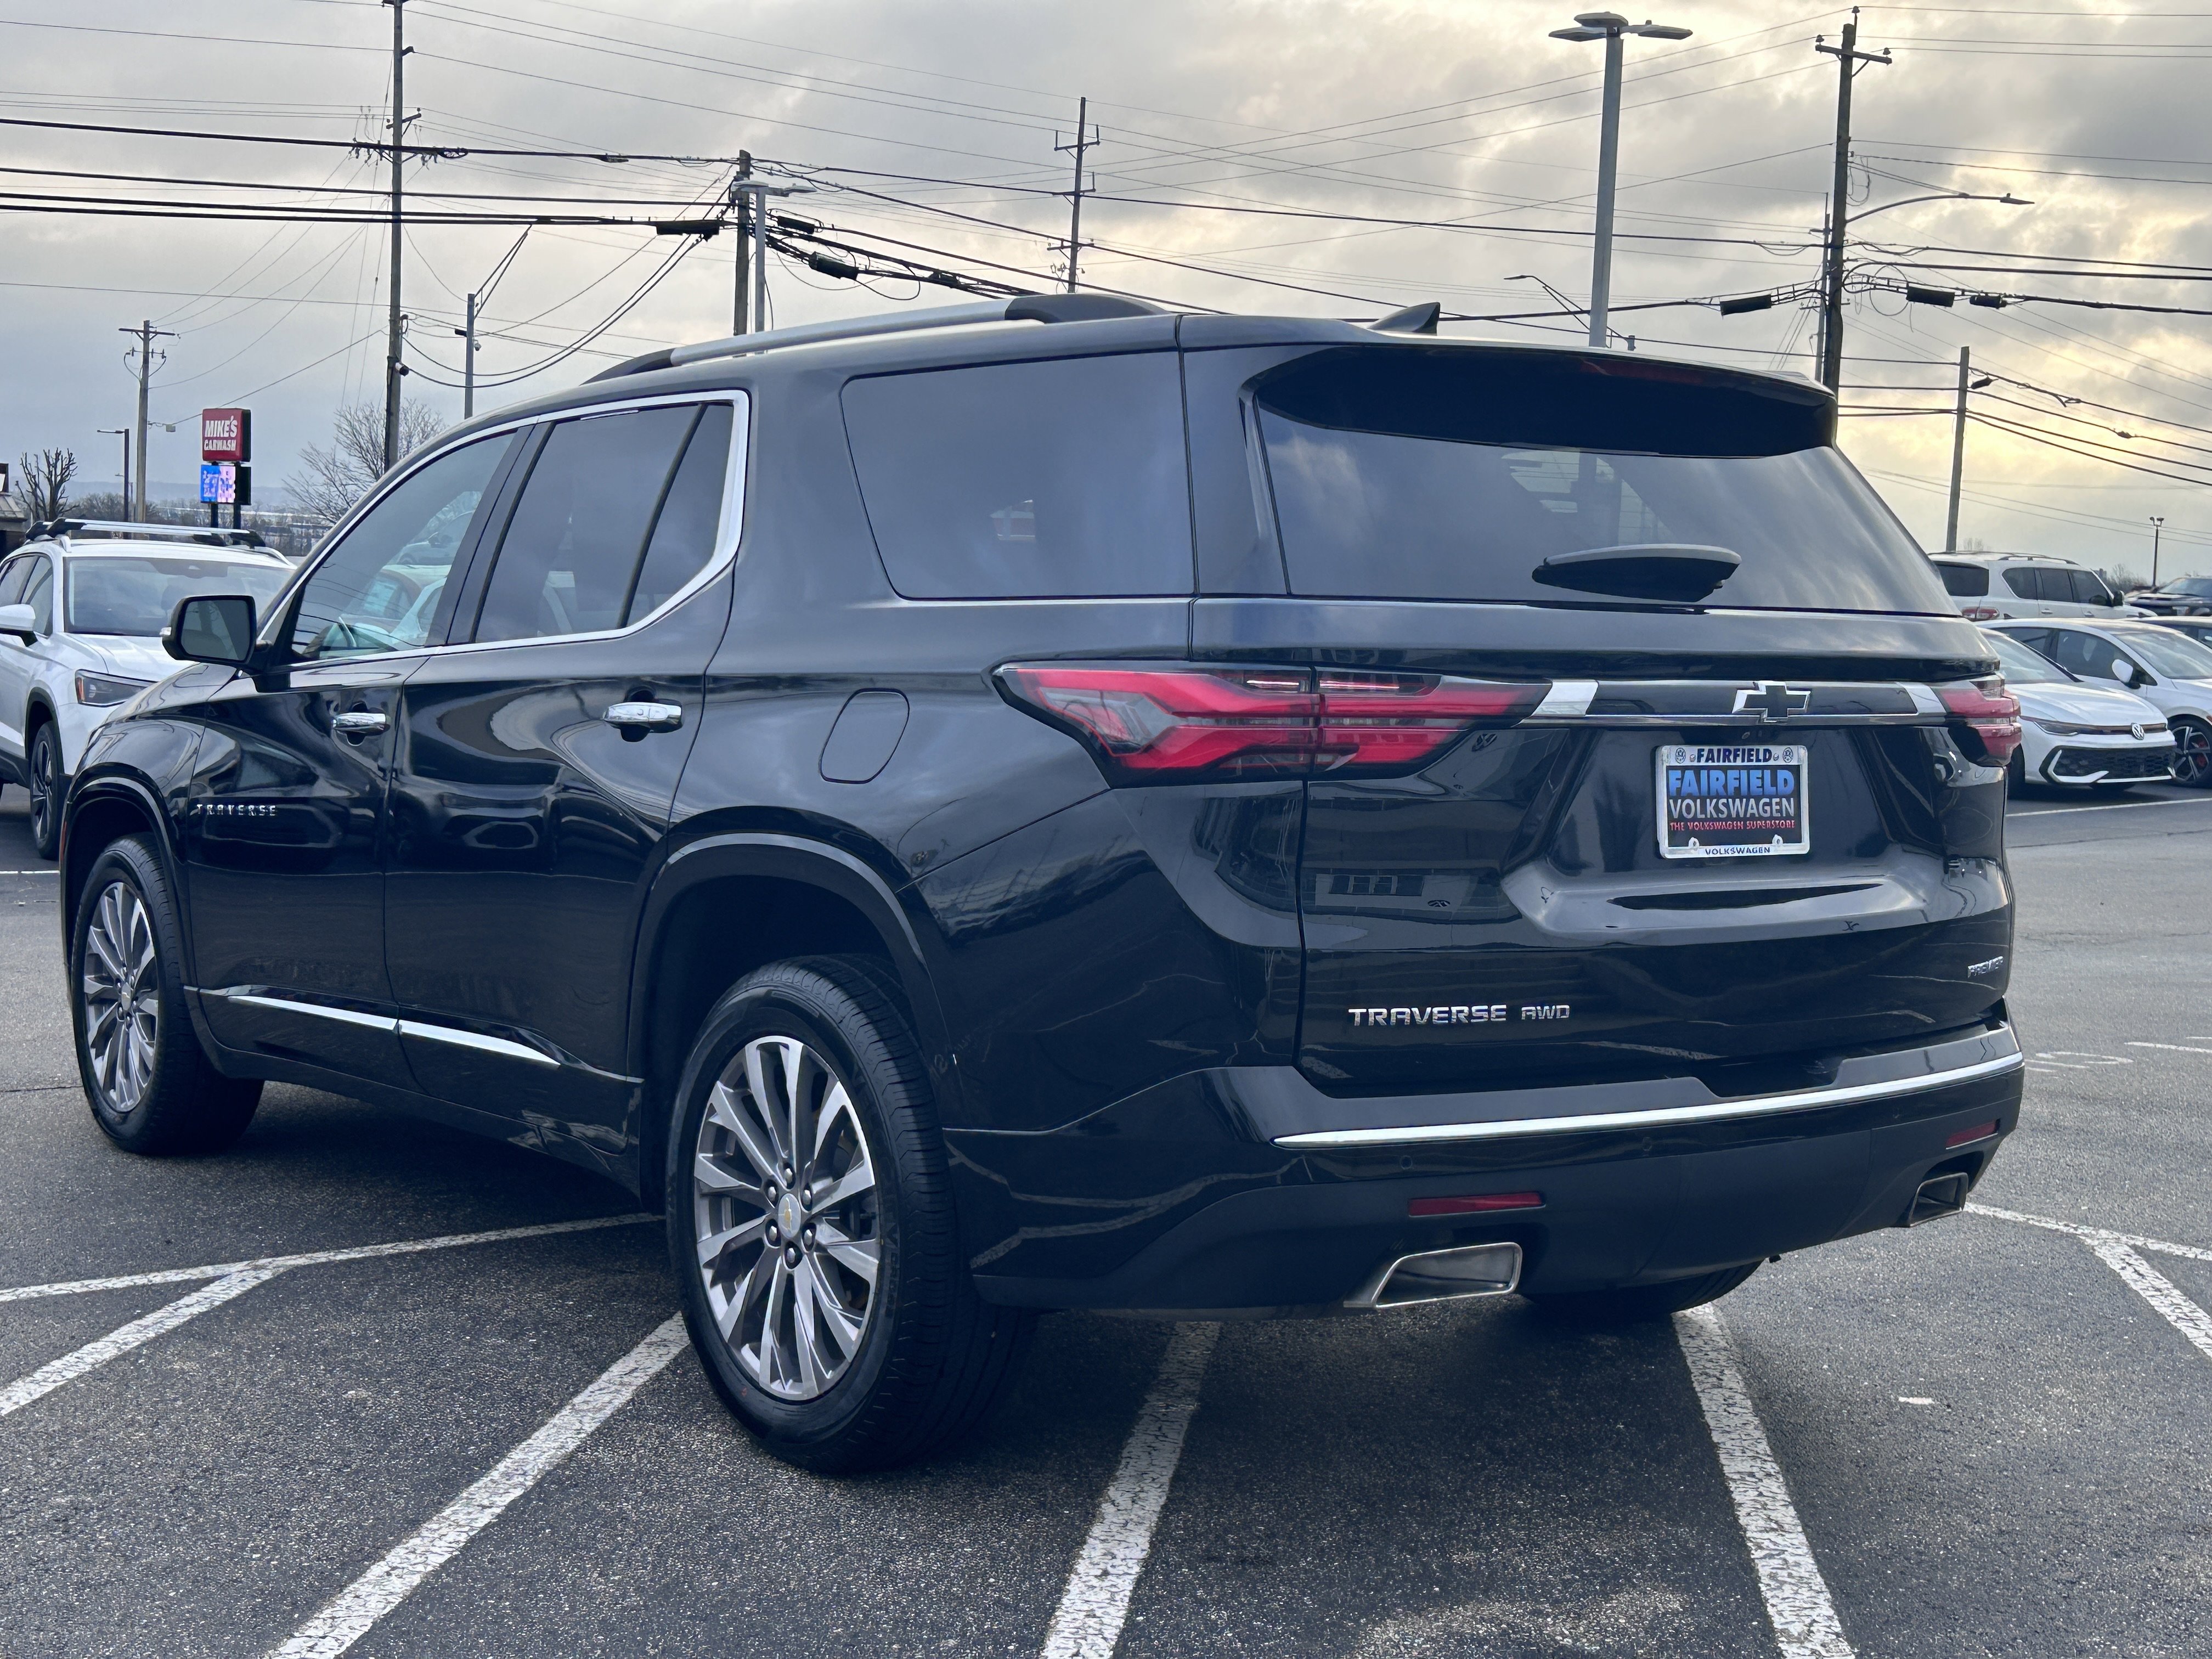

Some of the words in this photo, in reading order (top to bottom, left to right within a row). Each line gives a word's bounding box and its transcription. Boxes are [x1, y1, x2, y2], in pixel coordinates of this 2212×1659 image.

[205, 415, 238, 437] MIKE'S
[204, 439, 236, 451] CARWASH
[1697, 748, 1772, 763] FAIRFIELD
[1668, 770, 1795, 795] FAIRFIELD
[196, 804, 276, 816] TRAVERSE
[1669, 798, 1795, 819] VOLKSWAGEN
[1670, 822, 1684, 831] THE
[1688, 821, 1743, 830] VOLKSWAGEN
[1747, 820, 1795, 829] SUPERSTORE
[1705, 847, 1770, 855] VOLKSWAGEN
[1348, 1005, 1506, 1026] TRAVERSE
[1521, 1005, 1570, 1020] AWD
